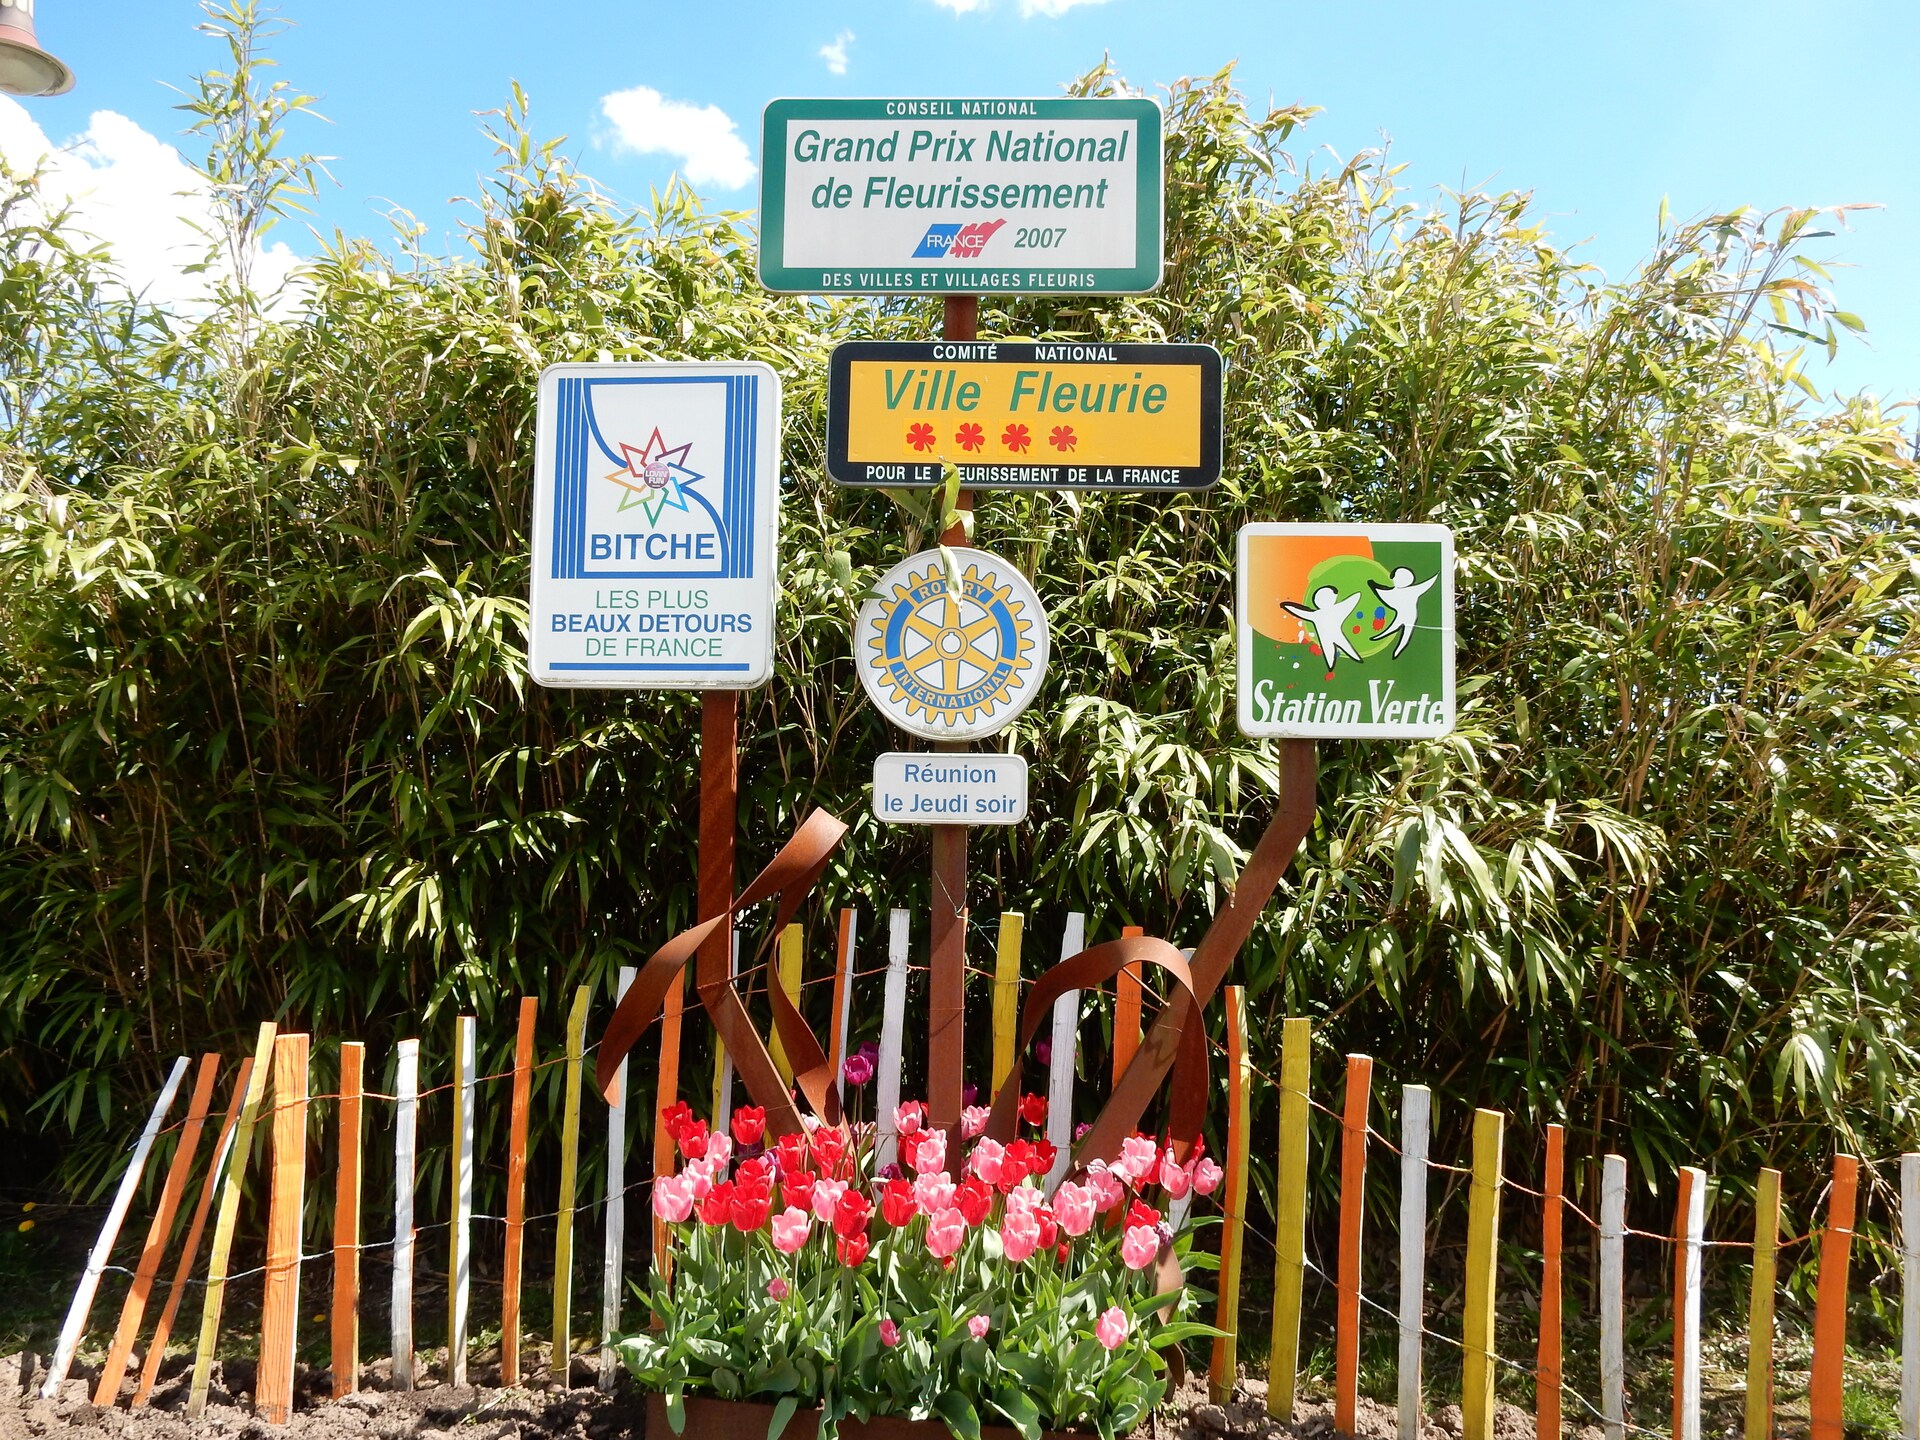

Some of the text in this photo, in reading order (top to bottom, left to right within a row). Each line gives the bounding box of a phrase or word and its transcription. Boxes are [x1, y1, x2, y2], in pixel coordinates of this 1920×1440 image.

[887, 102, 1037, 116] CONSEIL NATIONAL
[794, 130, 1129, 163] Grand Prix National
[811, 177, 1108, 209] de Fleurissement
[926, 234, 984, 248] FRANCE
[1014, 227, 1067, 249] 2007
[822, 272, 1095, 287] DES VILLES ET VILLAGES FLEURIS
[933, 343, 1118, 362] COMITÉ NATIONAL
[884, 369, 1168, 414] Ville Fleurie
[866, 465, 1180, 484] POUR LE FEURISSEMENT DE LA FRANCE
[590, 533, 715, 561] BITCHE
[595, 590, 709, 609] LES PLUS
[918, 581, 986, 599] RORY
[551, 614, 752, 633] BEAUX DETOURS
[586, 638, 723, 657] DE FRANCE
[894, 667, 1009, 708] INTERNATIONAL
[1253, 679, 1444, 724] Station Verte
[904, 762, 996, 783] Réunion
[884, 793, 1017, 813] le Jeudi soir
